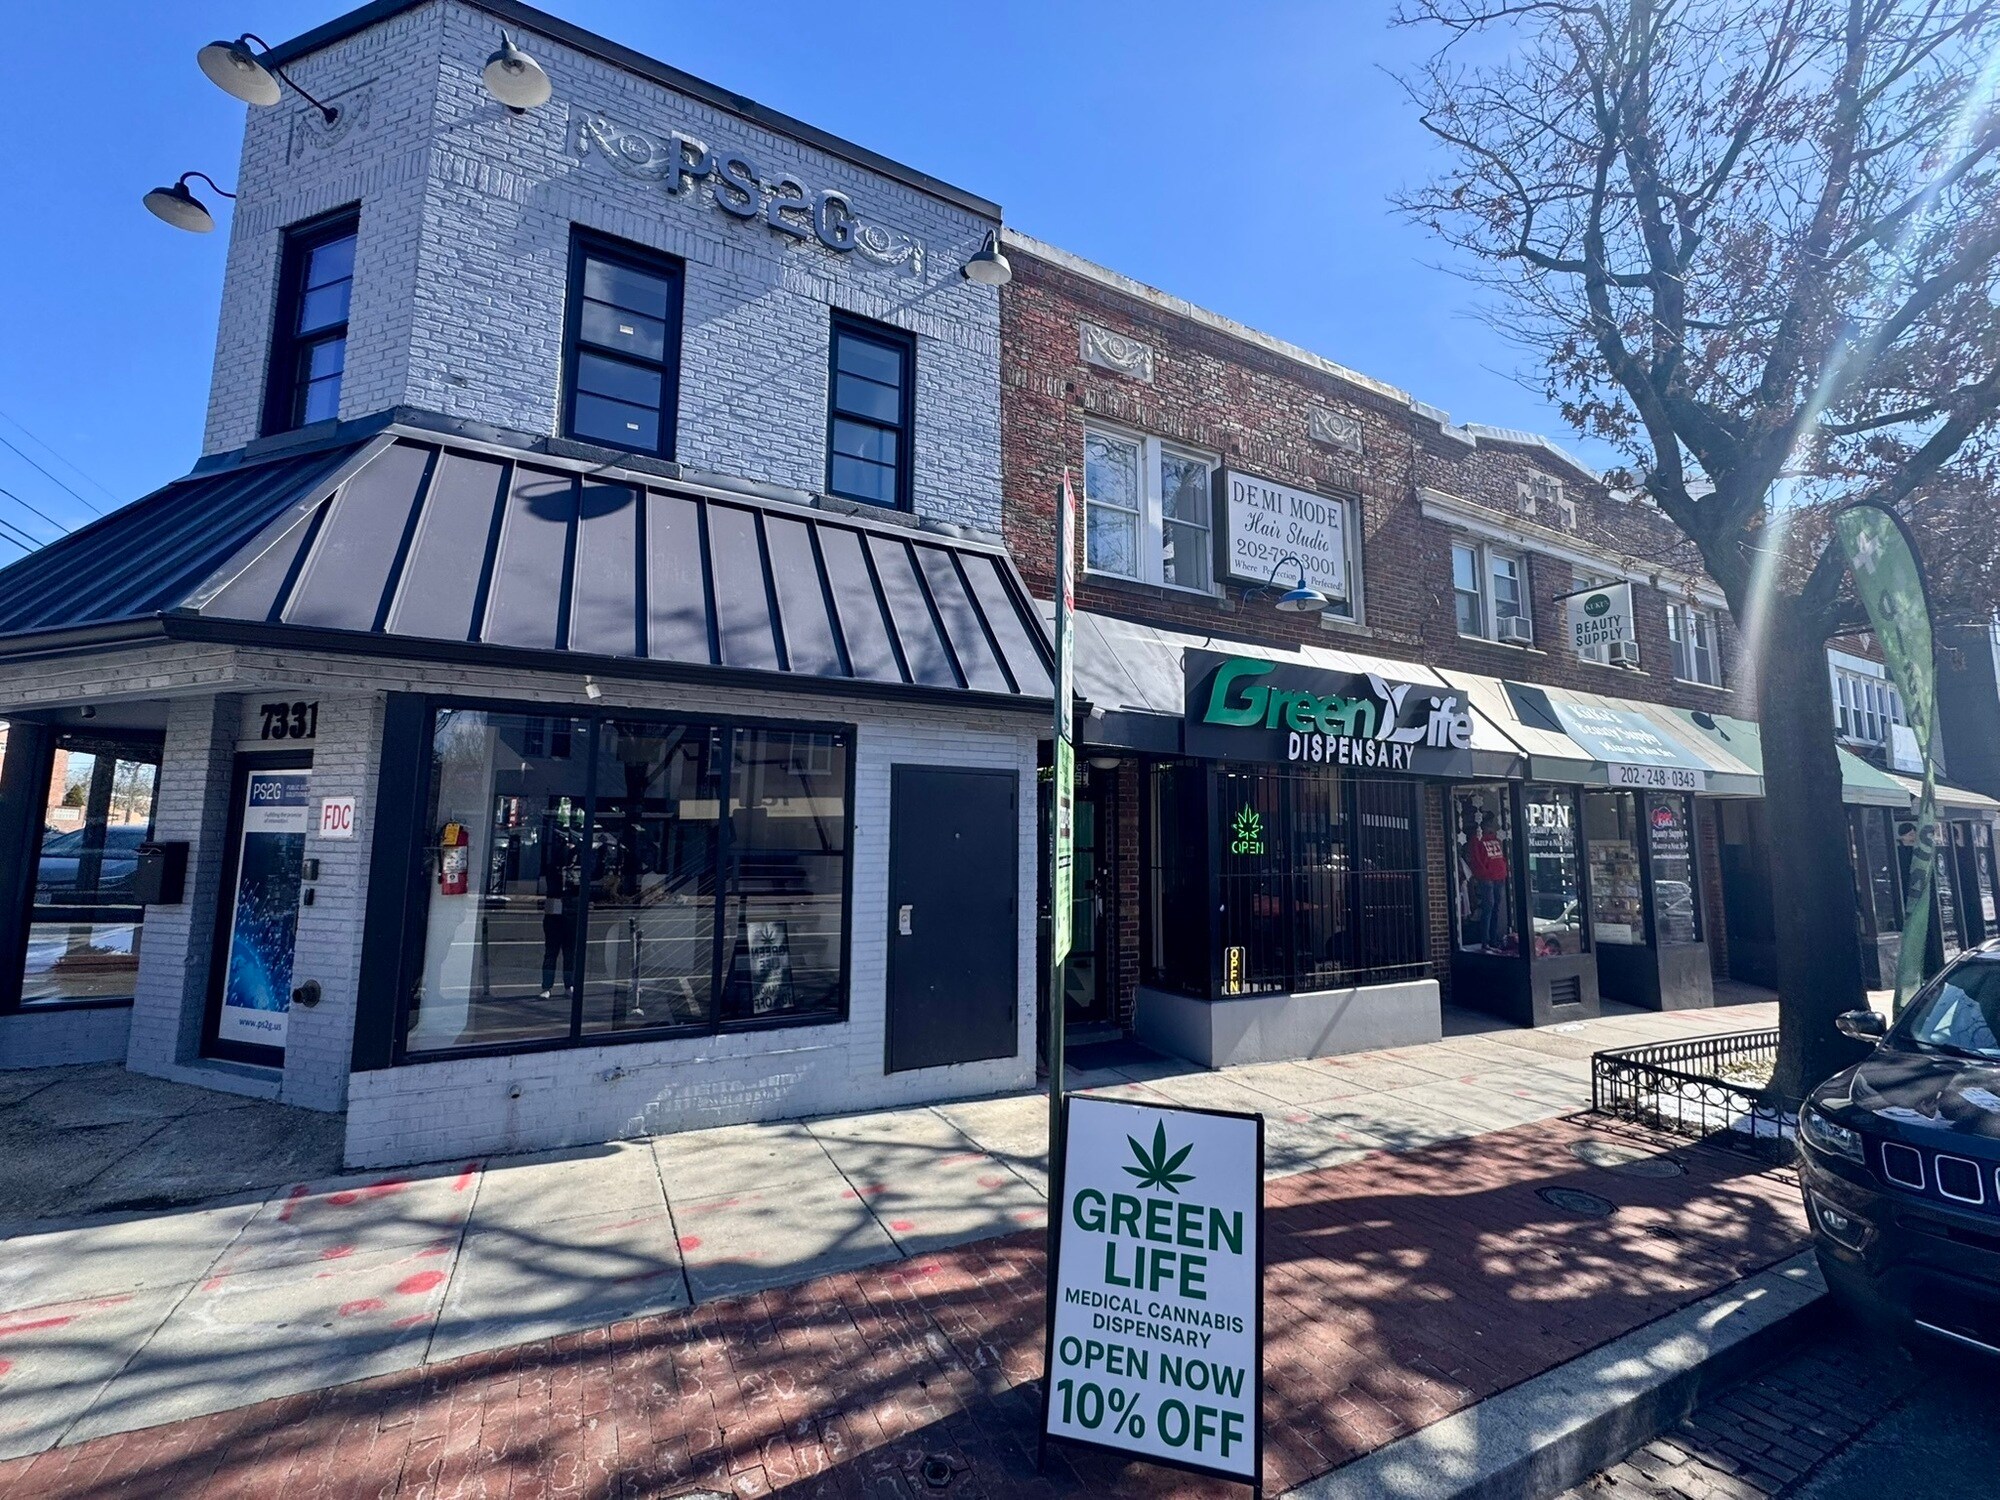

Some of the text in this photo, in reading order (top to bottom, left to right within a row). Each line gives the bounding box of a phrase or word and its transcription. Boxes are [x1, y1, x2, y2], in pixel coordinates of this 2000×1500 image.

[667, 130, 856, 254] PS2G
[1233, 481, 1339, 530] DEMI MODE
[1245, 512, 1329, 552] Hair Studio
[1234, 559, 1258, 573] Where
[1263, 566, 1297, 581] Peection
[1576, 615, 1621, 634] BEAUTY
[1576, 628, 1622, 646] SUPPLY
[260, 701, 319, 740] 7331
[1203, 658, 1474, 750] Green Life
[1288, 731, 1415, 769] DISPENSARY
[1573, 721, 1662, 746] Beauty Supply
[253, 782, 282, 800] PS2G
[323, 804, 351, 831] FDC
[1525, 803, 1570, 828] PEN
[1231, 841, 1264, 854] OPEN
[239, 1019, 282, 1031] www.ps2g.us
[1072, 1188, 1243, 1255] GREEN
[1104, 1241, 1207, 1300] LIFE
[1065, 1287, 1244, 1333] MEDICAL CANNABIS
[1093, 1313, 1211, 1349] DISPENSARY
[1059, 1335, 1245, 1399] OPEN NOW
[1057, 1378, 1244, 1458] 10% OFF
